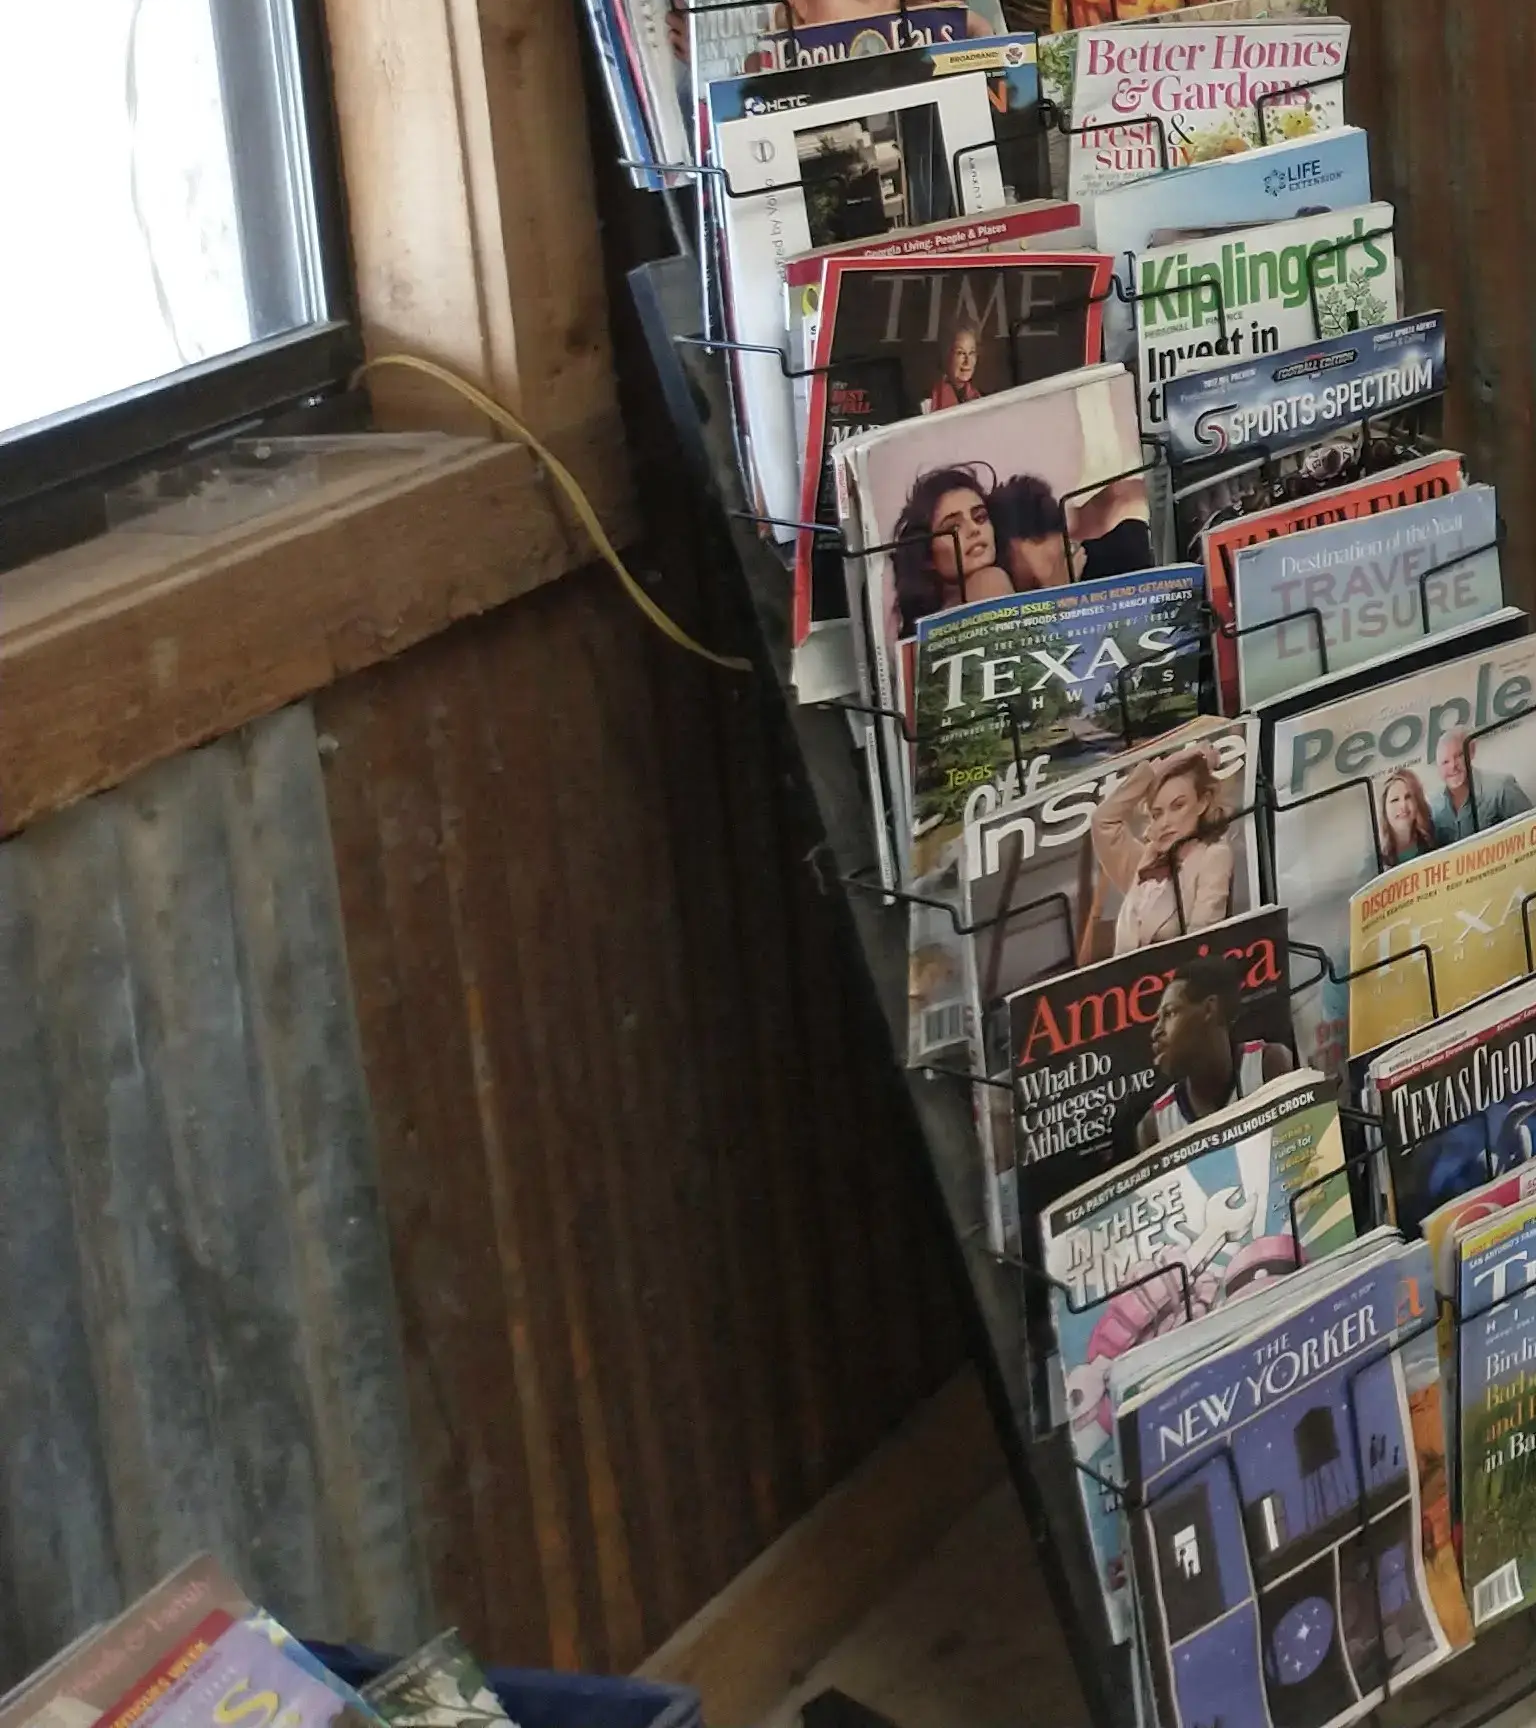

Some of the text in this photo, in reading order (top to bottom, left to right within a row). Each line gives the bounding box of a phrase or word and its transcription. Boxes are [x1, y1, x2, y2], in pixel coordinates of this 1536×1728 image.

[1087, 35, 1342, 77] Better Homes
[1111, 72, 1313, 114] & Gardens
[1288, 160, 1321, 182] LIFE
[1288, 171, 1341, 192] EXTENSION
[935, 223, 1007, 247] People & Places
[1141, 218, 1388, 328] Kiplinger's
[872, 271, 1062, 343] TIME
[1252, 321, 1279, 353] in
[1229, 358, 1432, 444] SPORTS SPECTRUM
[1281, 515, 1464, 577] Destination of the Year
[1274, 572, 1479, 660] LEISURE
[931, 626, 1179, 713] TEXAS
[1290, 662, 1534, 795] People
[947, 762, 992, 788] Texas
[1361, 872, 1421, 922] DISCOVER
[1424, 859, 1451, 891] THE
[1456, 831, 1527, 876] UNKNOWN
[1019, 1052, 1112, 1103] What Do
[1392, 1066, 1471, 1145] TEXAS
[1022, 1104, 1117, 1166] Athletes?
[1161, 1091, 1316, 1168] D'SOUZA'S JAILHOUSE CROCK
[1067, 1180, 1185, 1272] IN THESE
[1068, 1214, 1192, 1308] TIMES
[1159, 1304, 1378, 1462] NEW YORKER
[1254, 1334, 1290, 1366] THE
[1484, 1451, 1505, 1473] in
